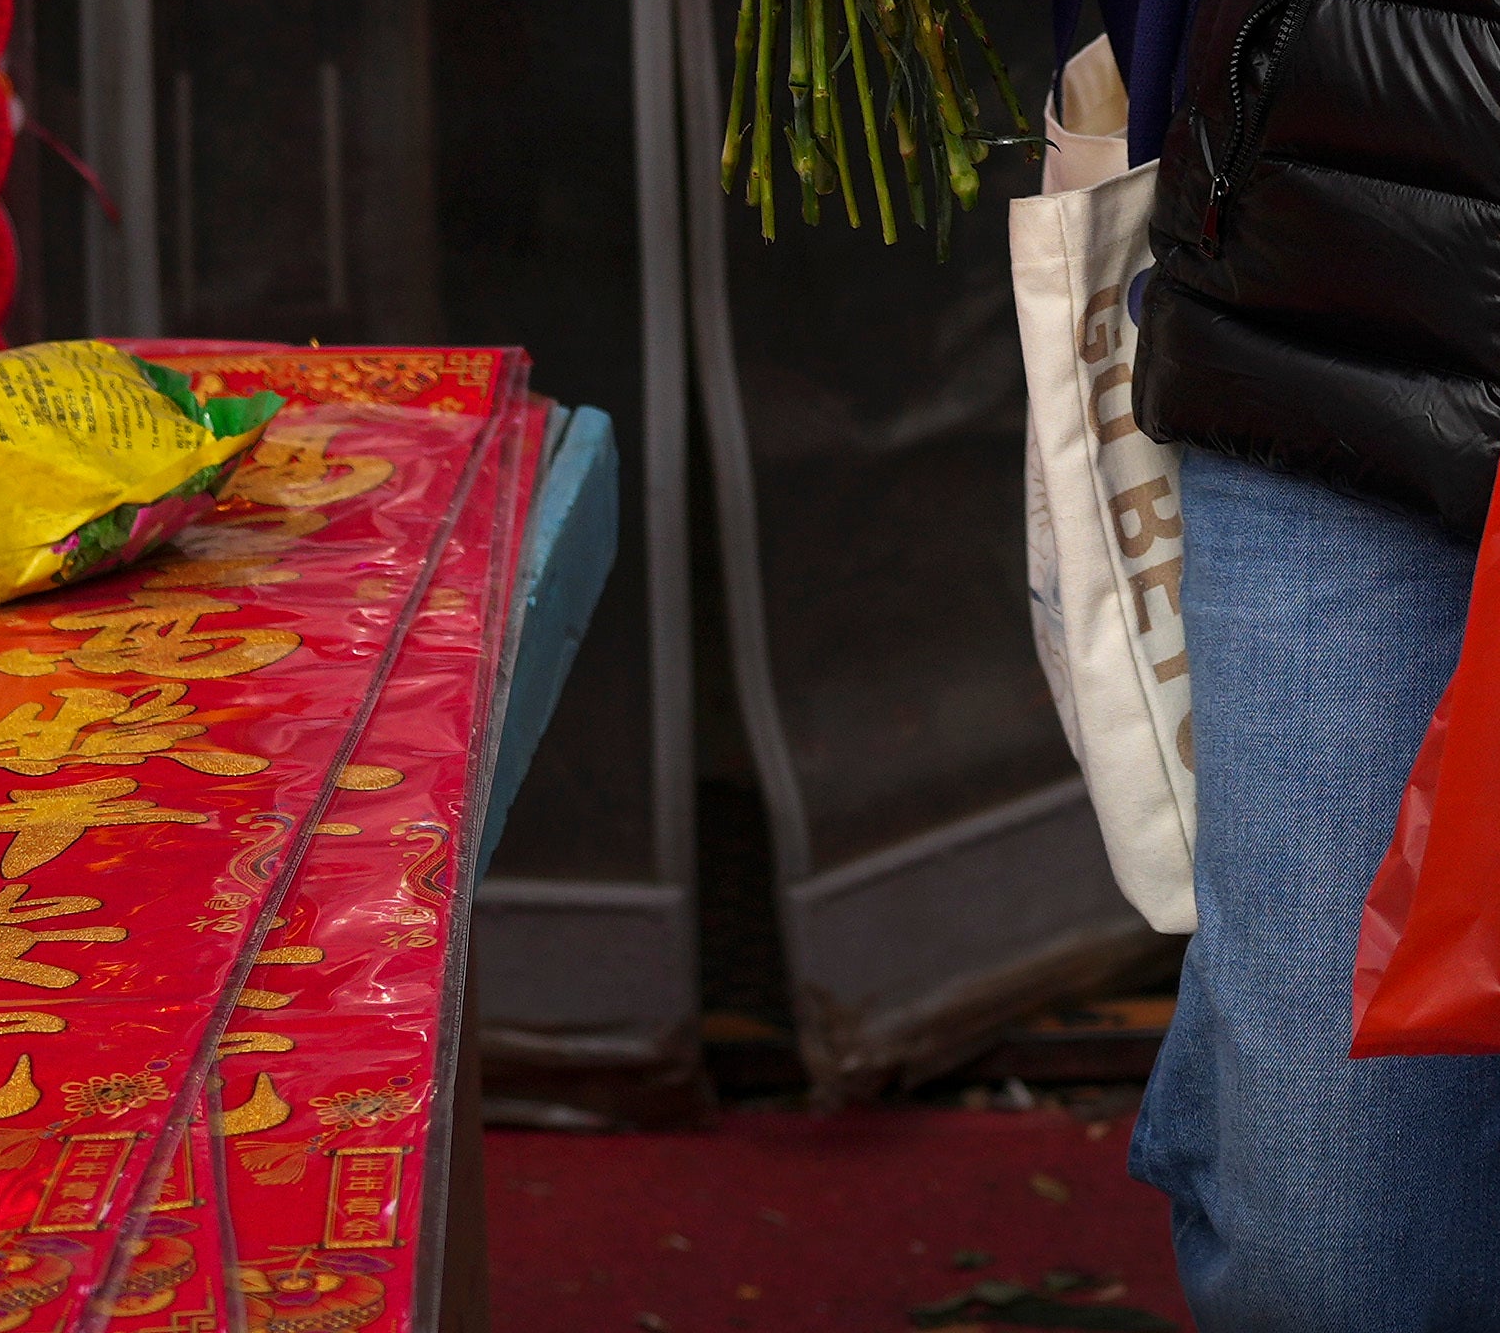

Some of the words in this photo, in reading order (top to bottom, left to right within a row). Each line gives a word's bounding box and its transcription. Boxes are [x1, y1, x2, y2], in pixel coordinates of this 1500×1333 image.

[50, 1142, 118, 1221] 年年有余
[341, 1156, 387, 1238] 年年有余
